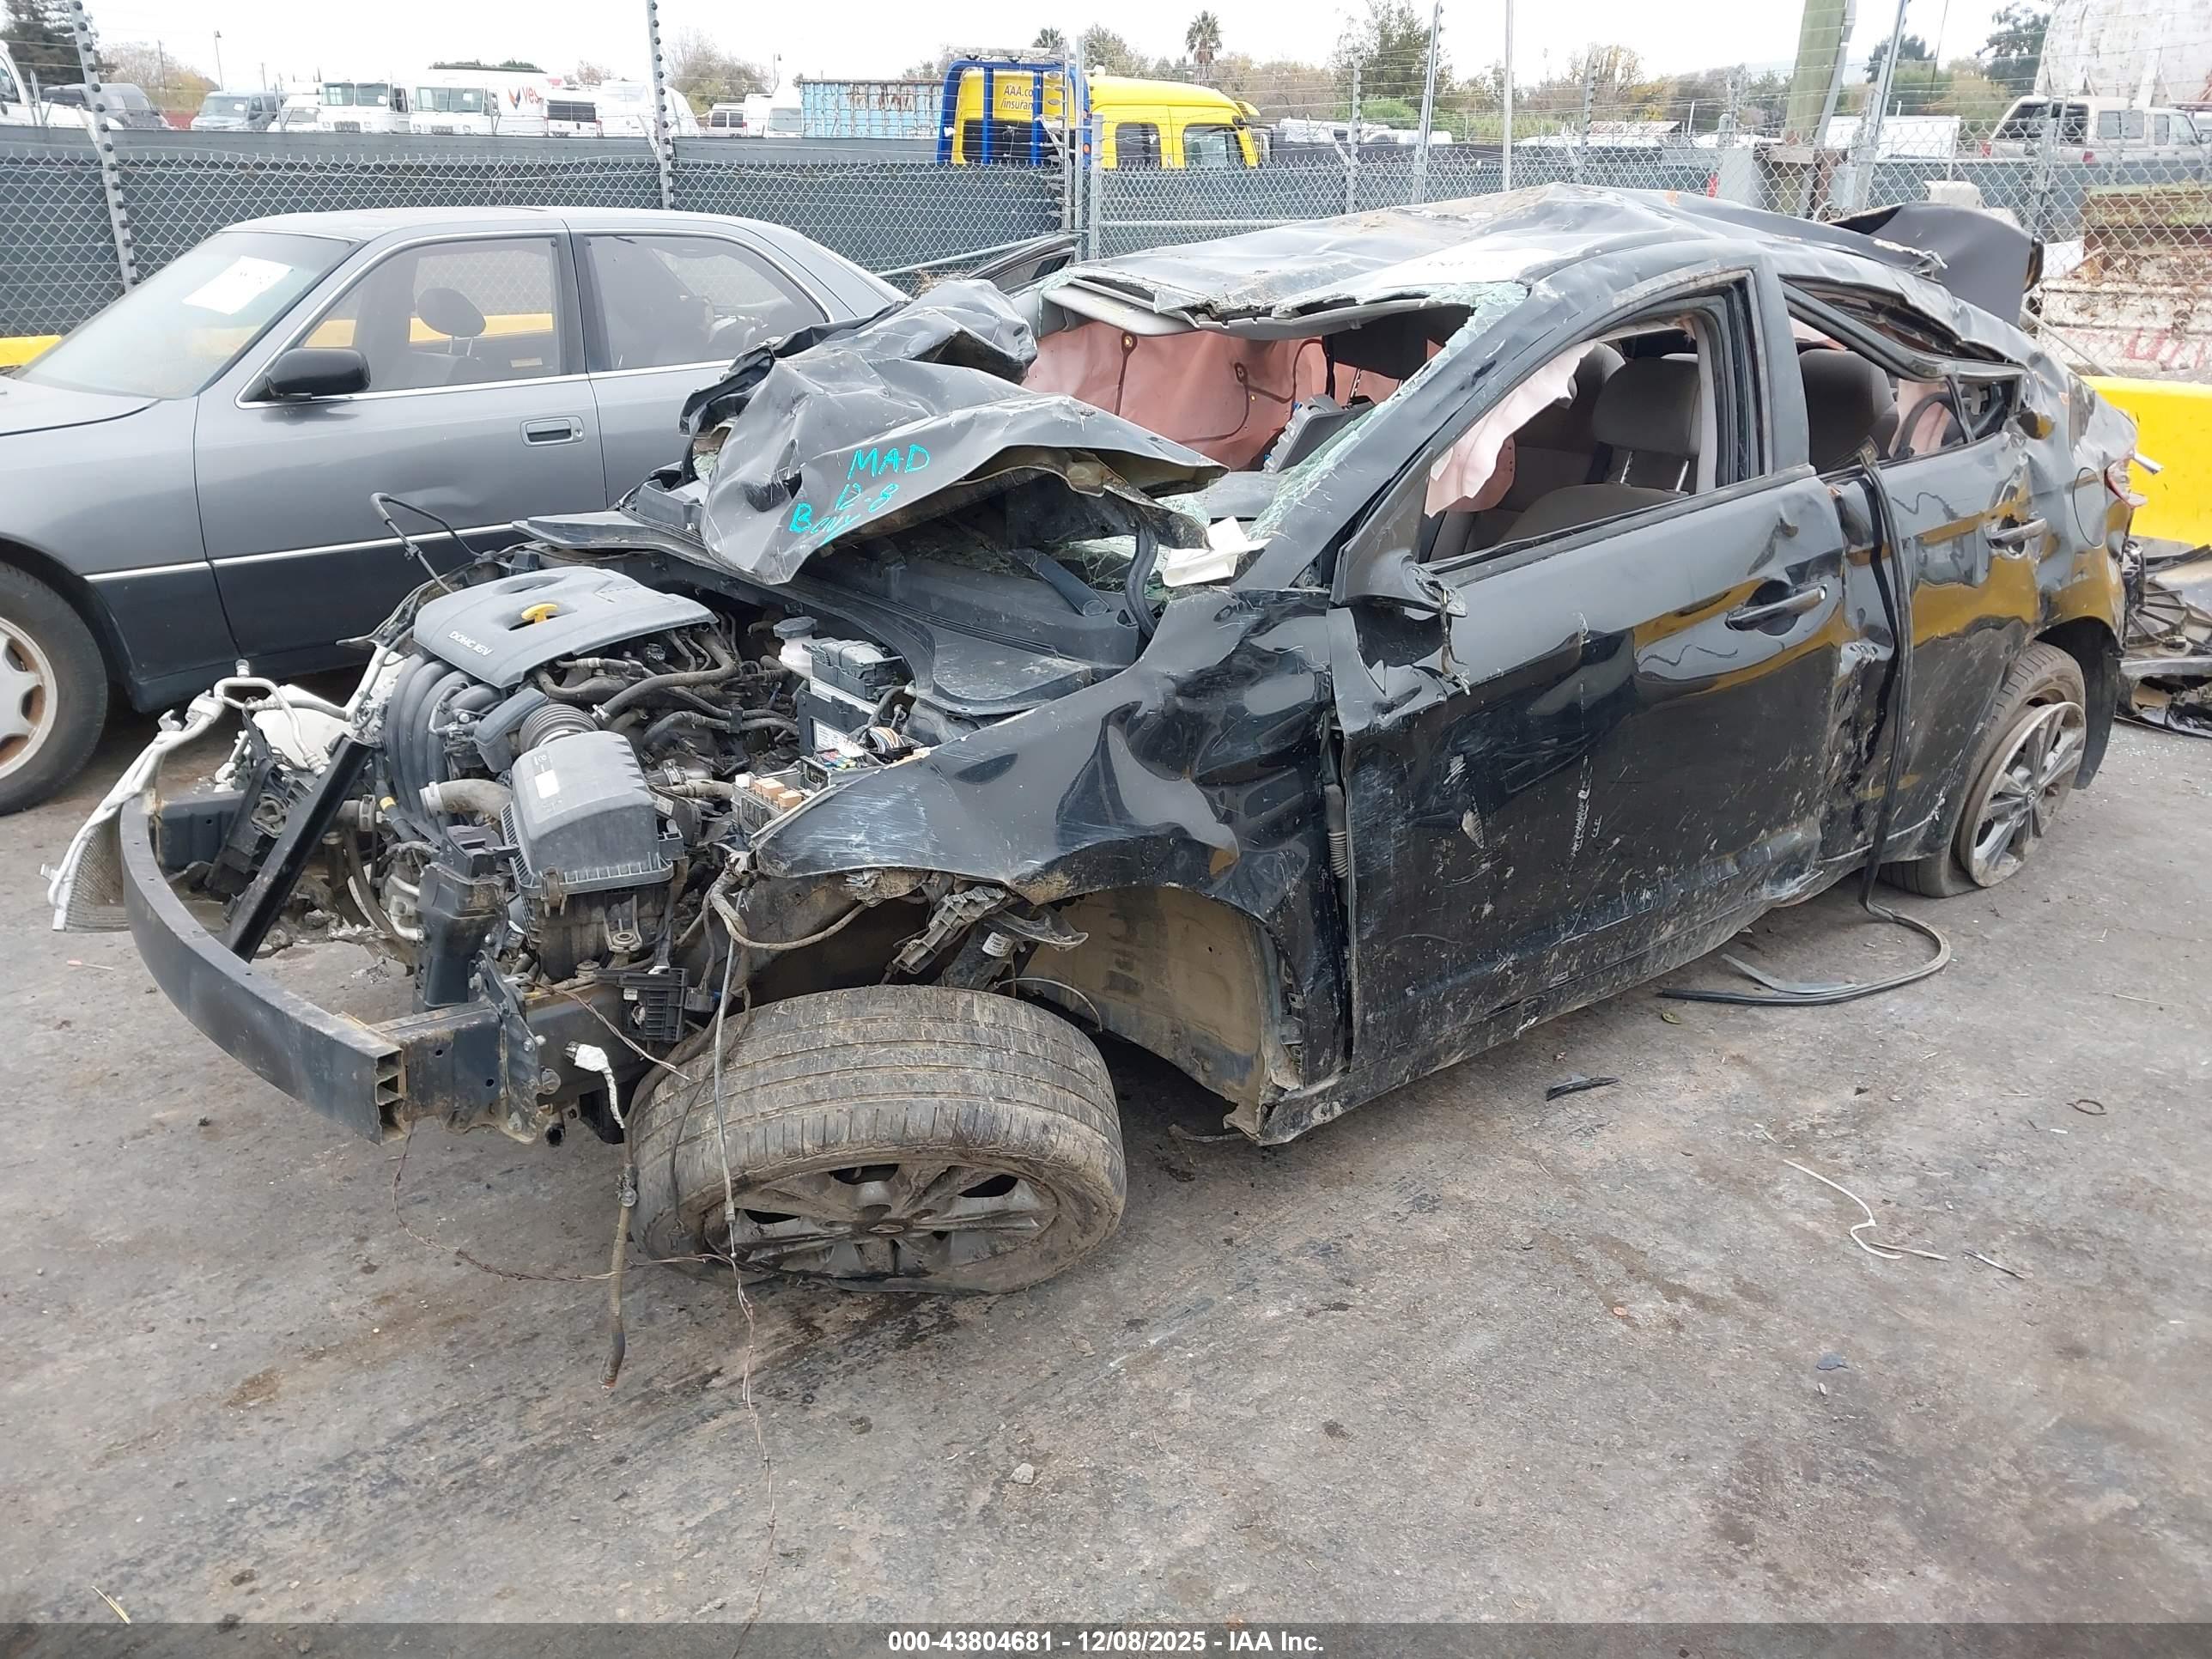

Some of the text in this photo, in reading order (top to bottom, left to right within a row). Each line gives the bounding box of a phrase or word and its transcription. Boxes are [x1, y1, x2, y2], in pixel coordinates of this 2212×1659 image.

[1003, 84, 1034, 97] AAA.co
[1000, 97, 1034, 111] /insuran
[848, 444, 930, 480] MAD
[447, 630, 495, 657] DOHC 16V
